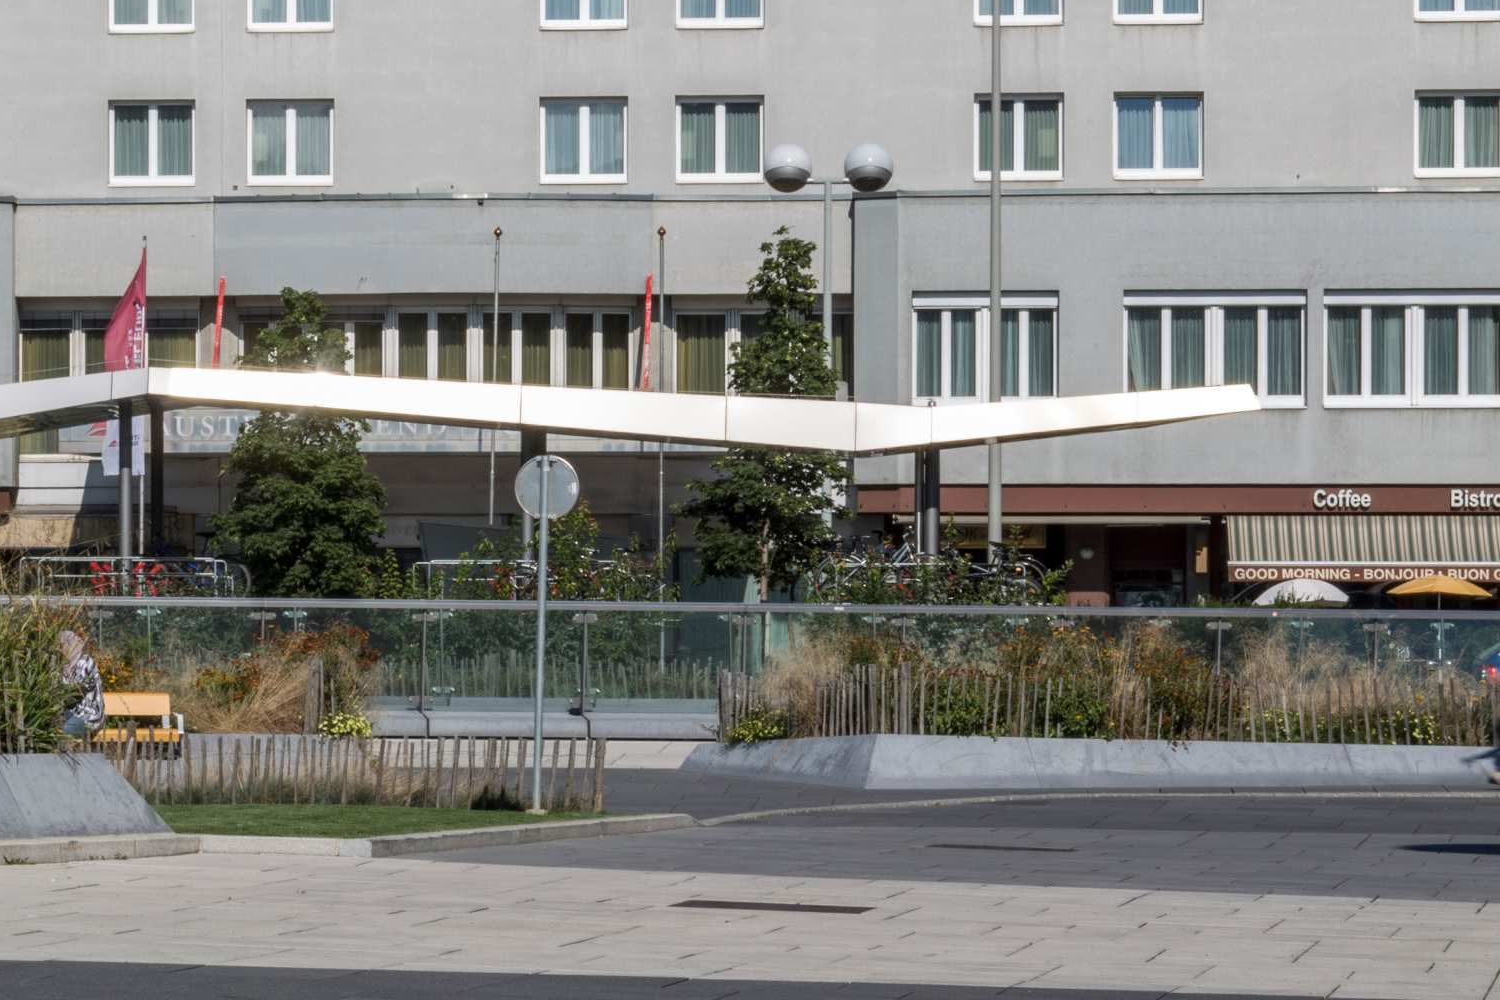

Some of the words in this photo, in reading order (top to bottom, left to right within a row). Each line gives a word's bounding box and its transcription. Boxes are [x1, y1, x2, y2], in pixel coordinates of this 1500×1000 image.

[1313, 489, 1372, 508] Coffee
[1450, 488, 1500, 508] Bistro
[1234, 568, 1278, 580] GOOD
[1281, 568, 1351, 580] MORNING
[1447, 568, 1490, 580] BUON
